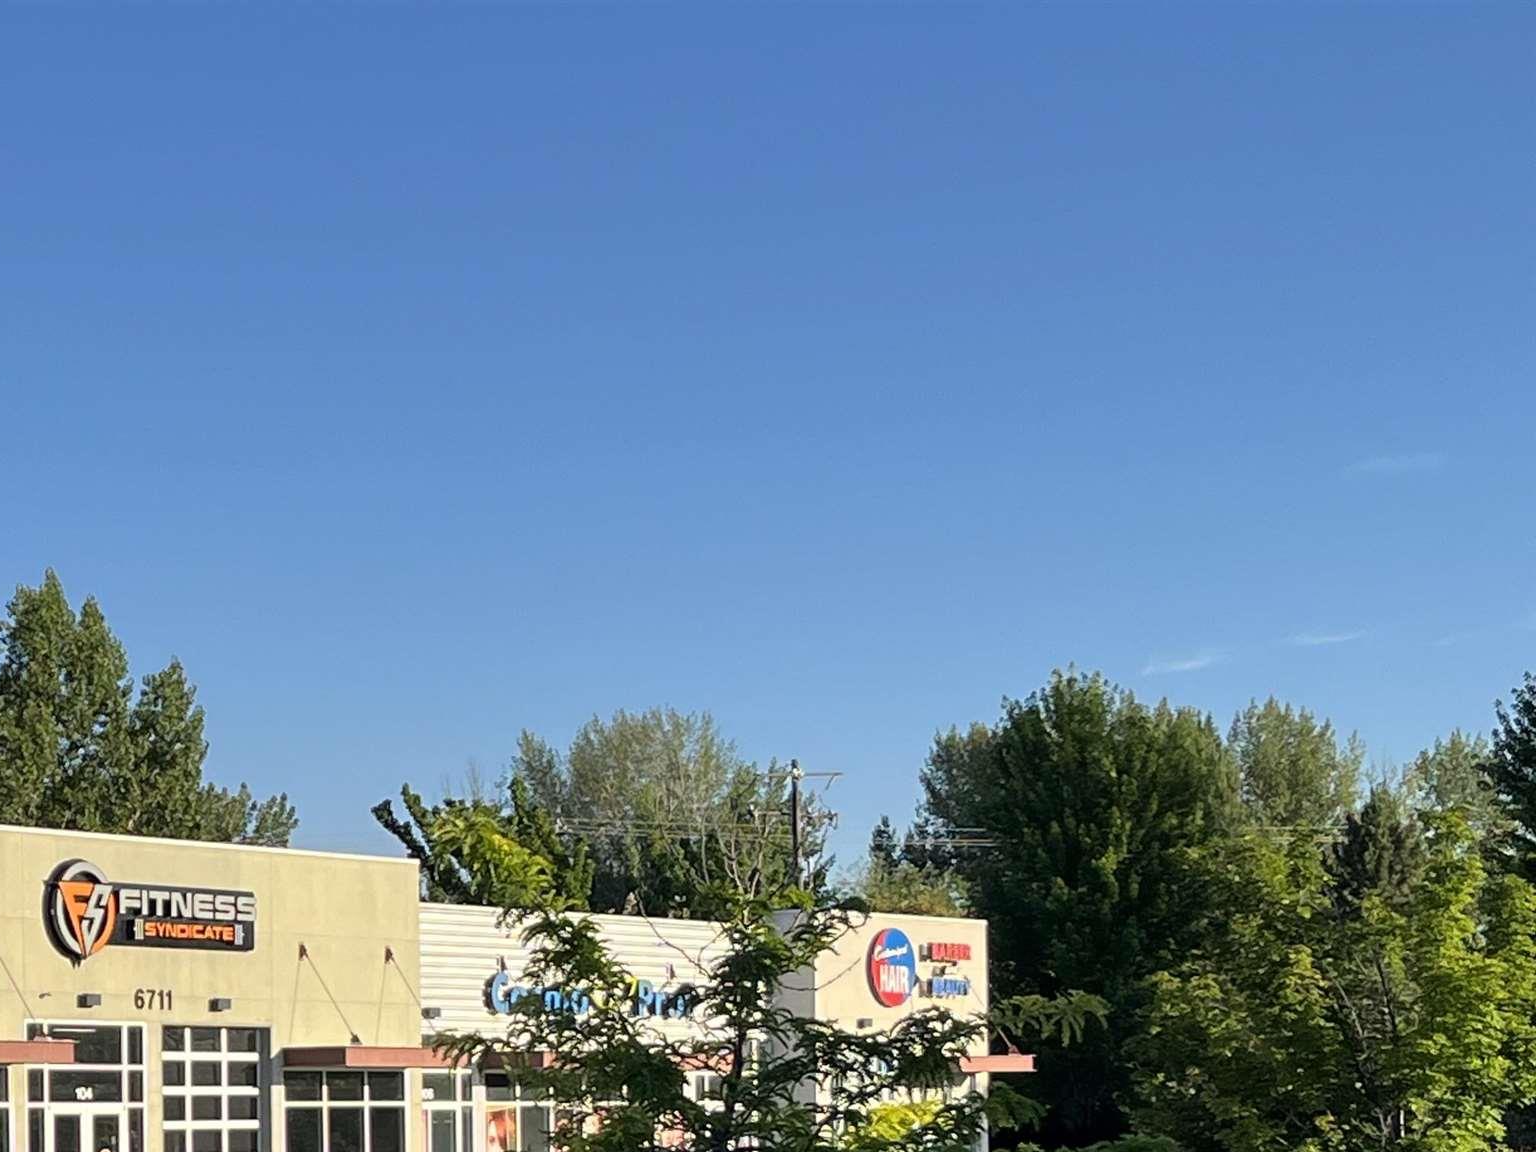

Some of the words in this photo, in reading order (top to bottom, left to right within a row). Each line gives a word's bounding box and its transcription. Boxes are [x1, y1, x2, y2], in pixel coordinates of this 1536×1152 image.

[119, 888, 257, 922] FITNESS
[144, 920, 235, 941] SYNDICATE
[879, 963, 910, 993] HAIR
[134, 988, 172, 1011] 6711
[75, 1086, 93, 1100] 104
